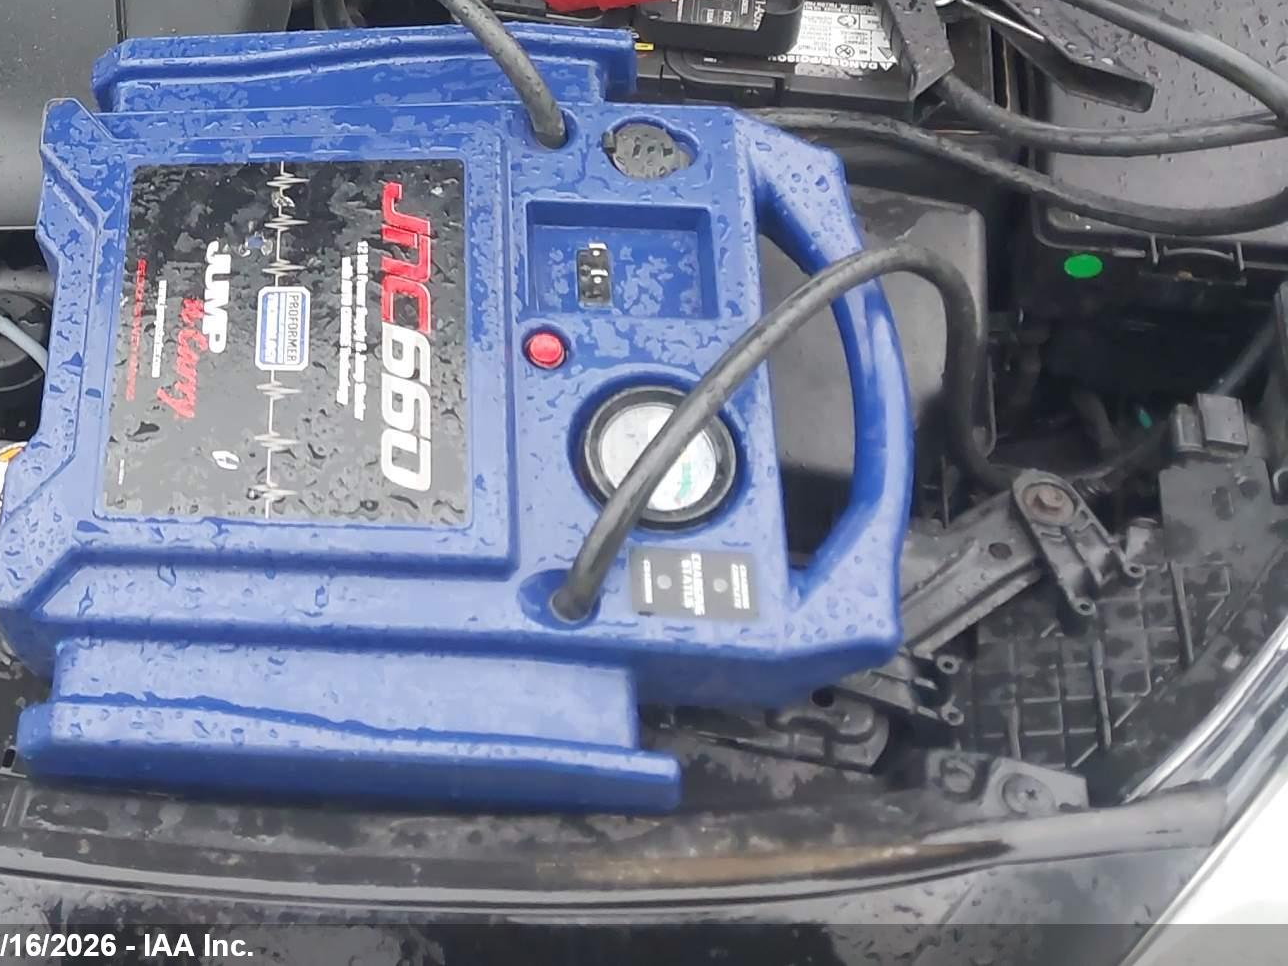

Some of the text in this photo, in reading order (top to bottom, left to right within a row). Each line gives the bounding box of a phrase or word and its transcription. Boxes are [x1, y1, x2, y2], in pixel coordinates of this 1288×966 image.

[202, 240, 231, 353] JUMP
[287, 294, 299, 362] PROFORMER
[379, 181, 433, 491] JNC660
[681, 559, 694, 609] STATUS
